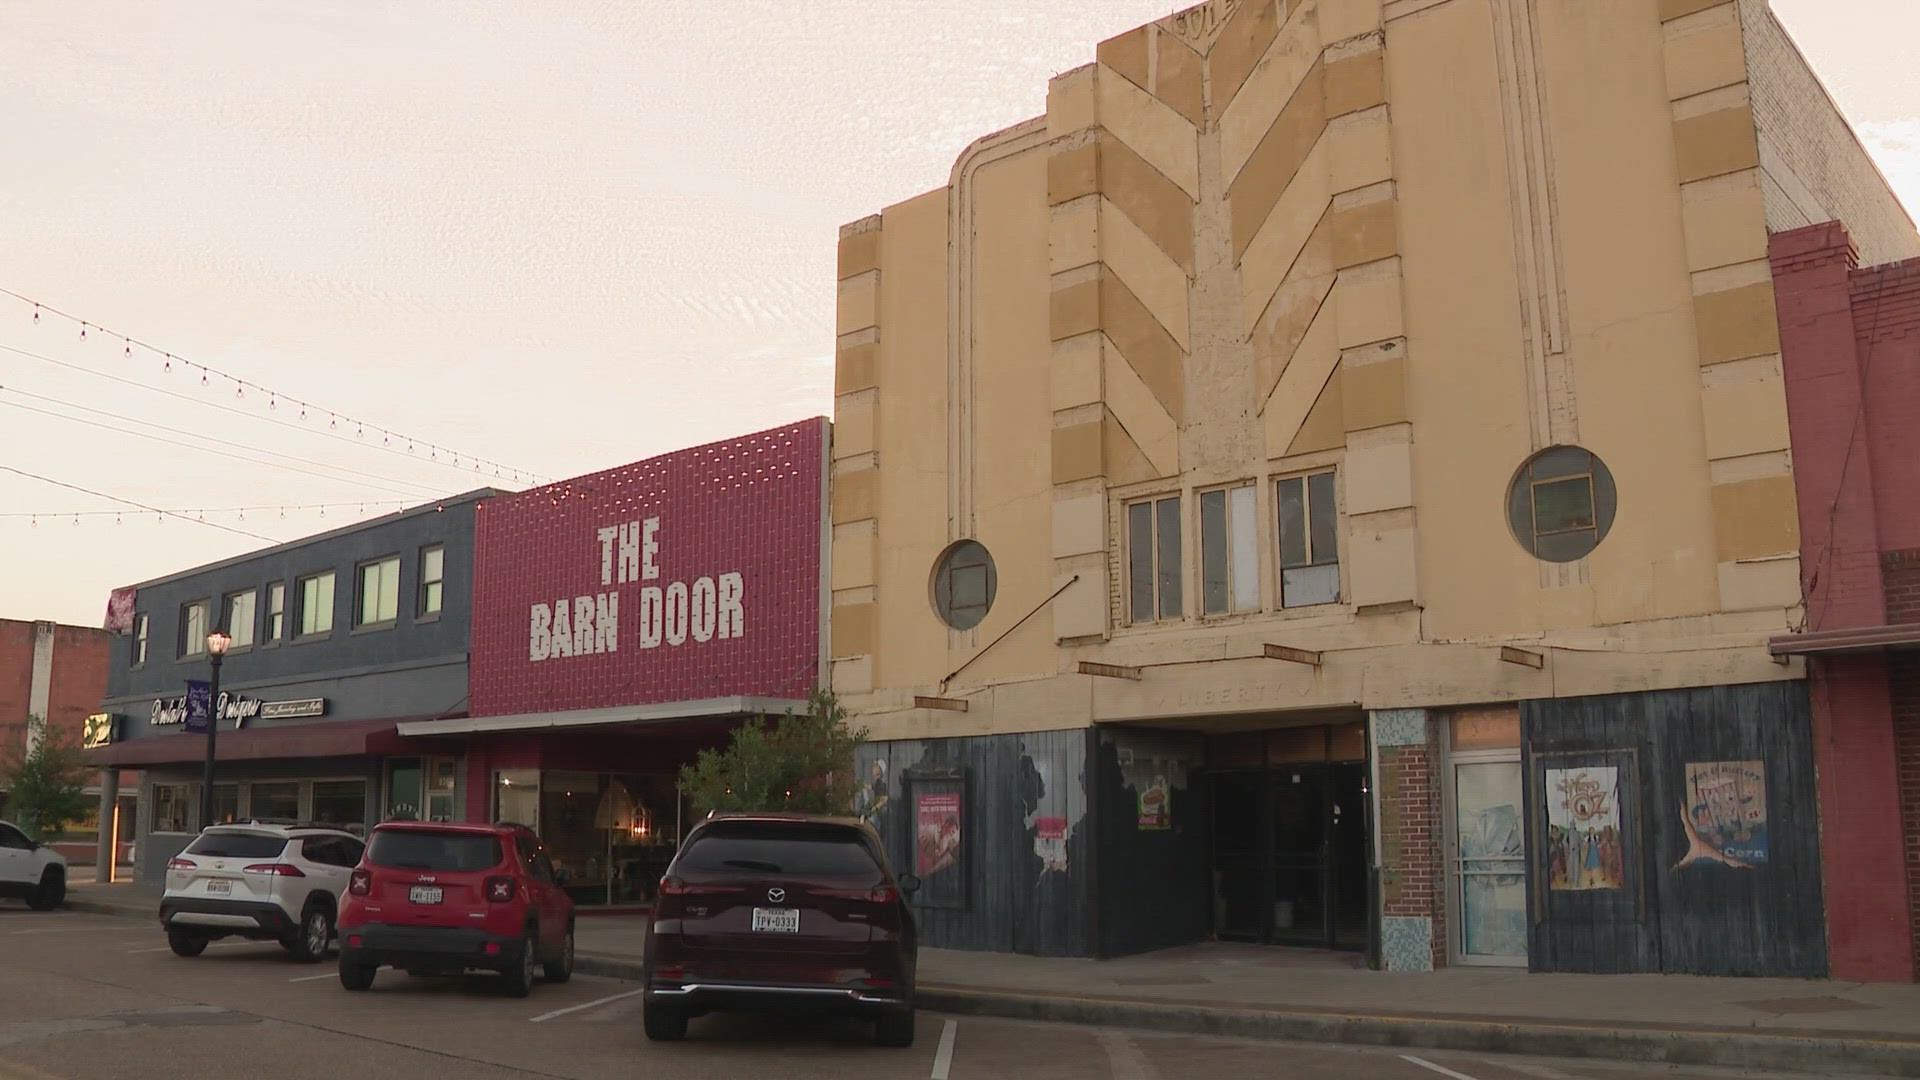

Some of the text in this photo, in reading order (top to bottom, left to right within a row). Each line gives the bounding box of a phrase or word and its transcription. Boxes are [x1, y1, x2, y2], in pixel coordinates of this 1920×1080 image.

[598, 516, 660, 585] THE
[529, 572, 745, 662] BARN DOOR
[1178, 681, 1284, 707] LIBERTY
[1570, 791, 1609, 820] OZ
[418, 874, 436, 882] Jeep
